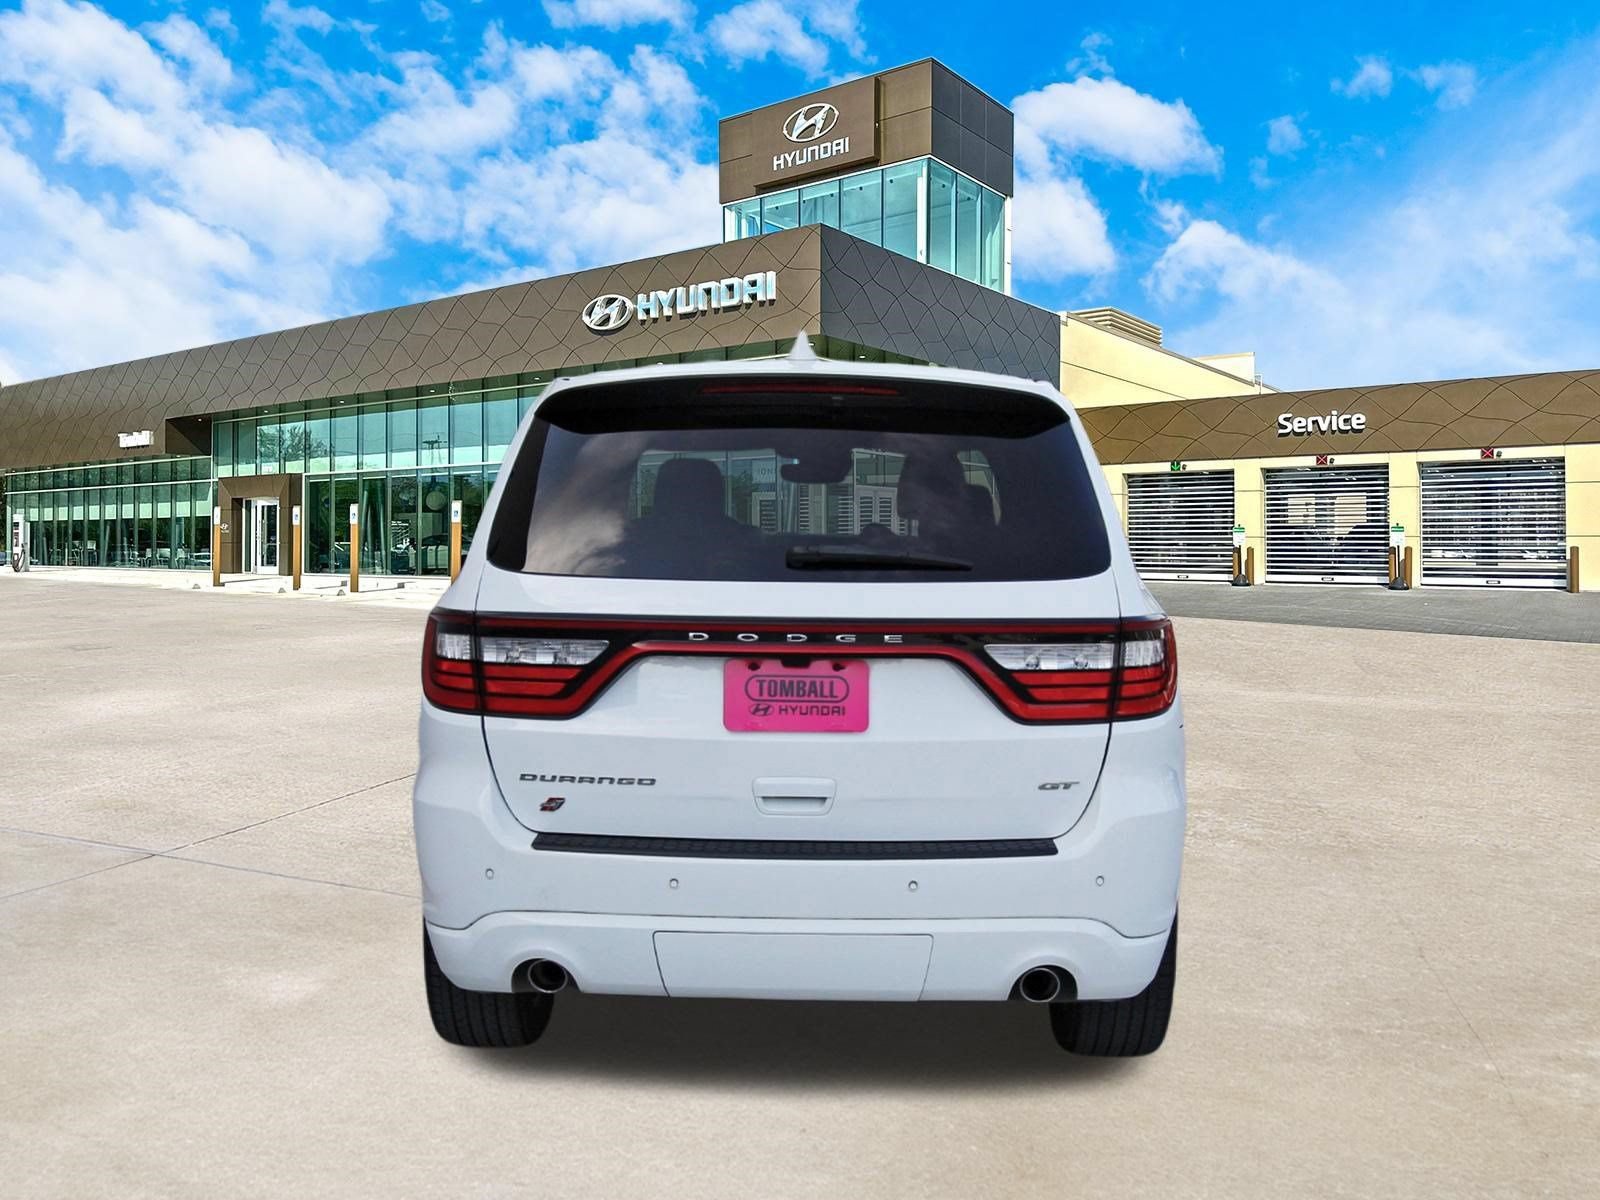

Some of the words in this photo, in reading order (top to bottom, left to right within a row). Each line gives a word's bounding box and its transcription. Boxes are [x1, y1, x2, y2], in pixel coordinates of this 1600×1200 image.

[773, 136, 850, 171] HYUNDAI
[636, 270, 777, 321] HYUNDAI
[1277, 410, 1366, 434] Service
[688, 632, 903, 643] DODGE
[756, 679, 838, 699] TOMBALL
[778, 705, 846, 717] HYUNDAI
[519, 773, 657, 786] DURANGO
[1038, 781, 1080, 790] GT
